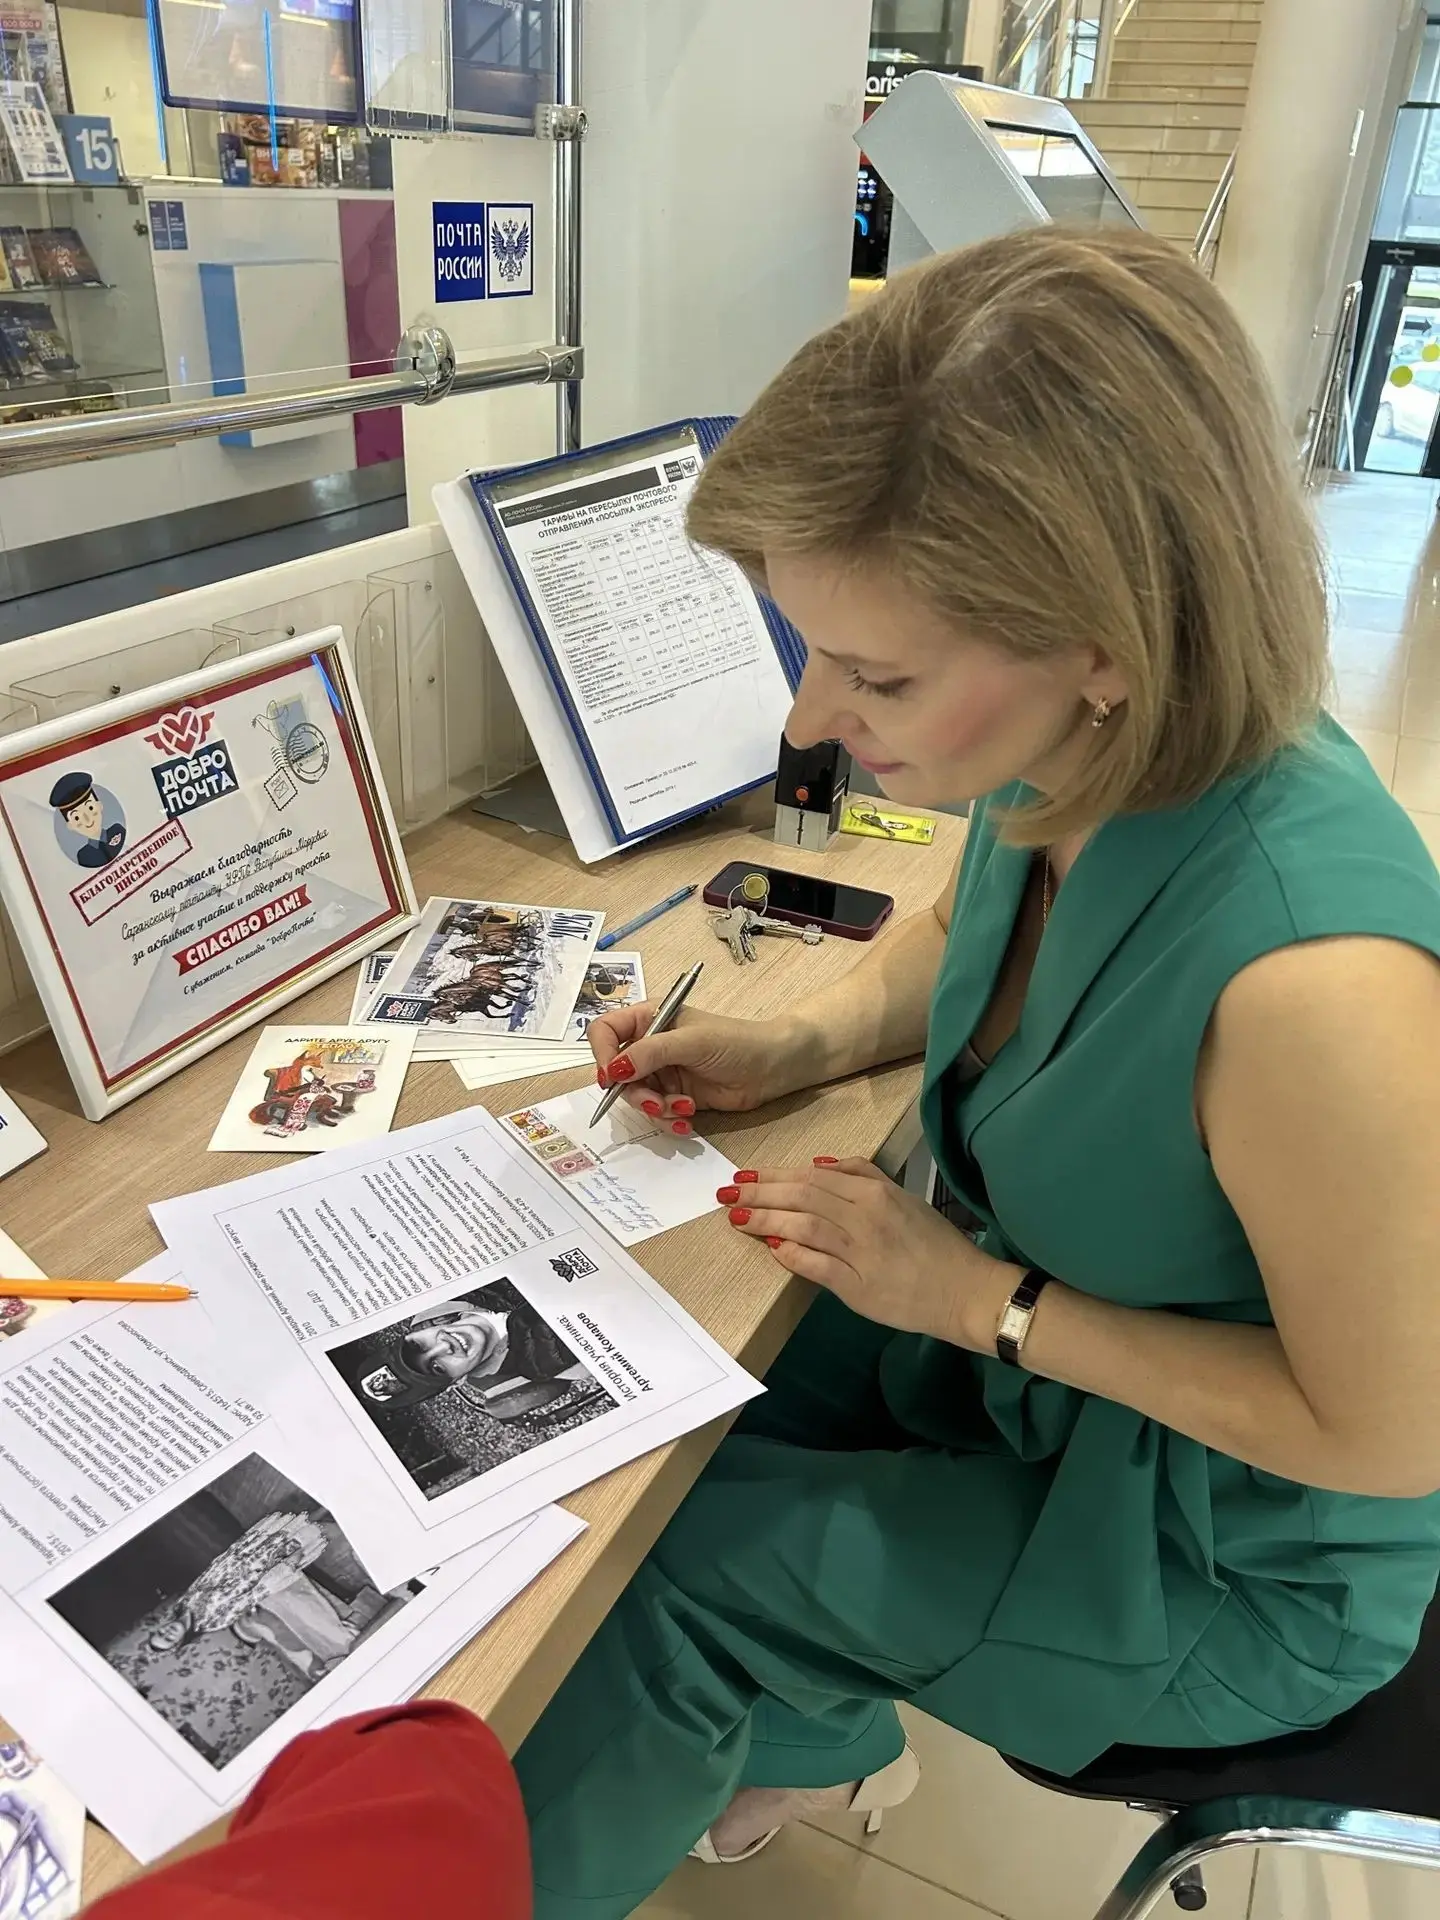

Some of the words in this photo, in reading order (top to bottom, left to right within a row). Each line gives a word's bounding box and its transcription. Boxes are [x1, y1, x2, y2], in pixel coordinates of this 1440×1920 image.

[76, 128, 113, 170] 15
[437, 223, 482, 247] ПОЧТА
[438, 256, 482, 280] РОССИИ
[538, 517, 594, 539] ОТПРАВЛЕНИЯ
[596, 505, 635, 523] «ПОСЫЛКА
[635, 494, 678, 511] ЭКСПРЕСС»
[541, 513, 575, 527] ТАРИФЫ
[576, 509, 588, 519] НА
[588, 495, 632, 514] ПЕРЕСЫЛКУ
[633, 484, 677, 502] ПОЧТОВОГО
[161, 749, 226, 793] ДОБРО
[166, 771, 234, 812] ПОЧТА
[79, 827, 178, 903] БЛАГОДАРСТВЕННОЕ
[114, 857, 157, 893] ПИСЬМО
[149, 866, 215, 903] Выражаем
[217, 827, 292, 869] благодарность
[131, 950, 144, 966] за
[147, 923, 195, 953] активное
[197, 901, 235, 929] участие
[237, 897, 243, 906] и
[245, 871, 292, 901] поддержку
[294, 851, 330, 875] проекта
[186, 915, 260, 964] СПАСИБО
[263, 892, 301, 923] ВАМ!
[547, 912, 596, 941] 2026
[183, 985, 189, 995] С
[235, 943, 265, 965] команда
[224, 1223, 241, 1244] августа
[242, 1251, 264, 1278] рождения
[565, 1254, 587, 1274] ДОБРО
[572, 1251, 594, 1271] ПОЧТА
[306, 1289, 323, 1303] ДЦП
[347, 1305, 360, 1319] Наш
[285, 1314, 306, 1340] Комаров
[556, 1314, 604, 1361] участника:
[577, 1312, 615, 1352] Комаров
[69, 1339, 83, 1350] они
[80, 1333, 94, 1344] она
[92, 1343, 112, 1361] Также
[24, 1365, 46, 1383] школе
[52, 1356, 89, 1387] заниматься
[80, 1349, 121, 1382] коллективом
[610, 1351, 653, 1391] Артемий
[16, 1374, 37, 1392] Алина
[47, 1368, 79, 1393] развитая
[88, 1370, 112, 1391] студию
[598, 1361, 637, 1401] История
[2, 1397, 18, 1408] для
[3, 1380, 35, 1407] обучается
[35, 1390, 47, 1400] что
[48, 1385, 92, 1423] адаптирована
[86, 1386, 107, 1402] ходит
[124, 1385, 158, 1414] Постоянно
[143, 1385, 179, 1413] различных
[205, 1388, 231, 1410] 164515,
[14, 1408, 37, 1427] классе
[32, 1406, 48, 1420] Она
[55, 1408, 64, 1416] на
[79, 1396, 122, 1431] общительная
[104, 1401, 118, 1412] она
[176, 1411, 186, 1420] на
[251, 1410, 264, 1419] 93
[62, 1416, 95, 1444] Несмотря
[116, 1411, 140, 1430] школы
[147, 1420, 171, 1439] группе
[193, 1410, 233, 1441] занимается
[69, 1439, 81, 1448] по
[90, 1422, 115, 1443] хорошо
[121, 1430, 141, 1447] очень
[138, 1429, 161, 1448] Кроме
[184, 1419, 222, 1448] выступают
[35, 1426, 83, 1469] коррекционном
[113, 1441, 128, 1453] она
[138, 1445, 153, 1459] Она
[174, 1442, 200, 1463] пением
[0, 1452, 42, 1488] (остаточное
[78, 1447, 119, 1481] проблемами
[125, 1453, 147, 1470] видит
[87, 1472, 113, 1493] учится
[117, 1463, 146, 1486] системе
[145, 1468, 167, 1486] плохо
[39, 1486, 67, 1511] слепота
[108, 1491, 131, 1511] Алина
[121, 1484, 145, 1502] детей
[144, 1485, 156, 1495] по
[48, 1537, 71, 1556] 2015
